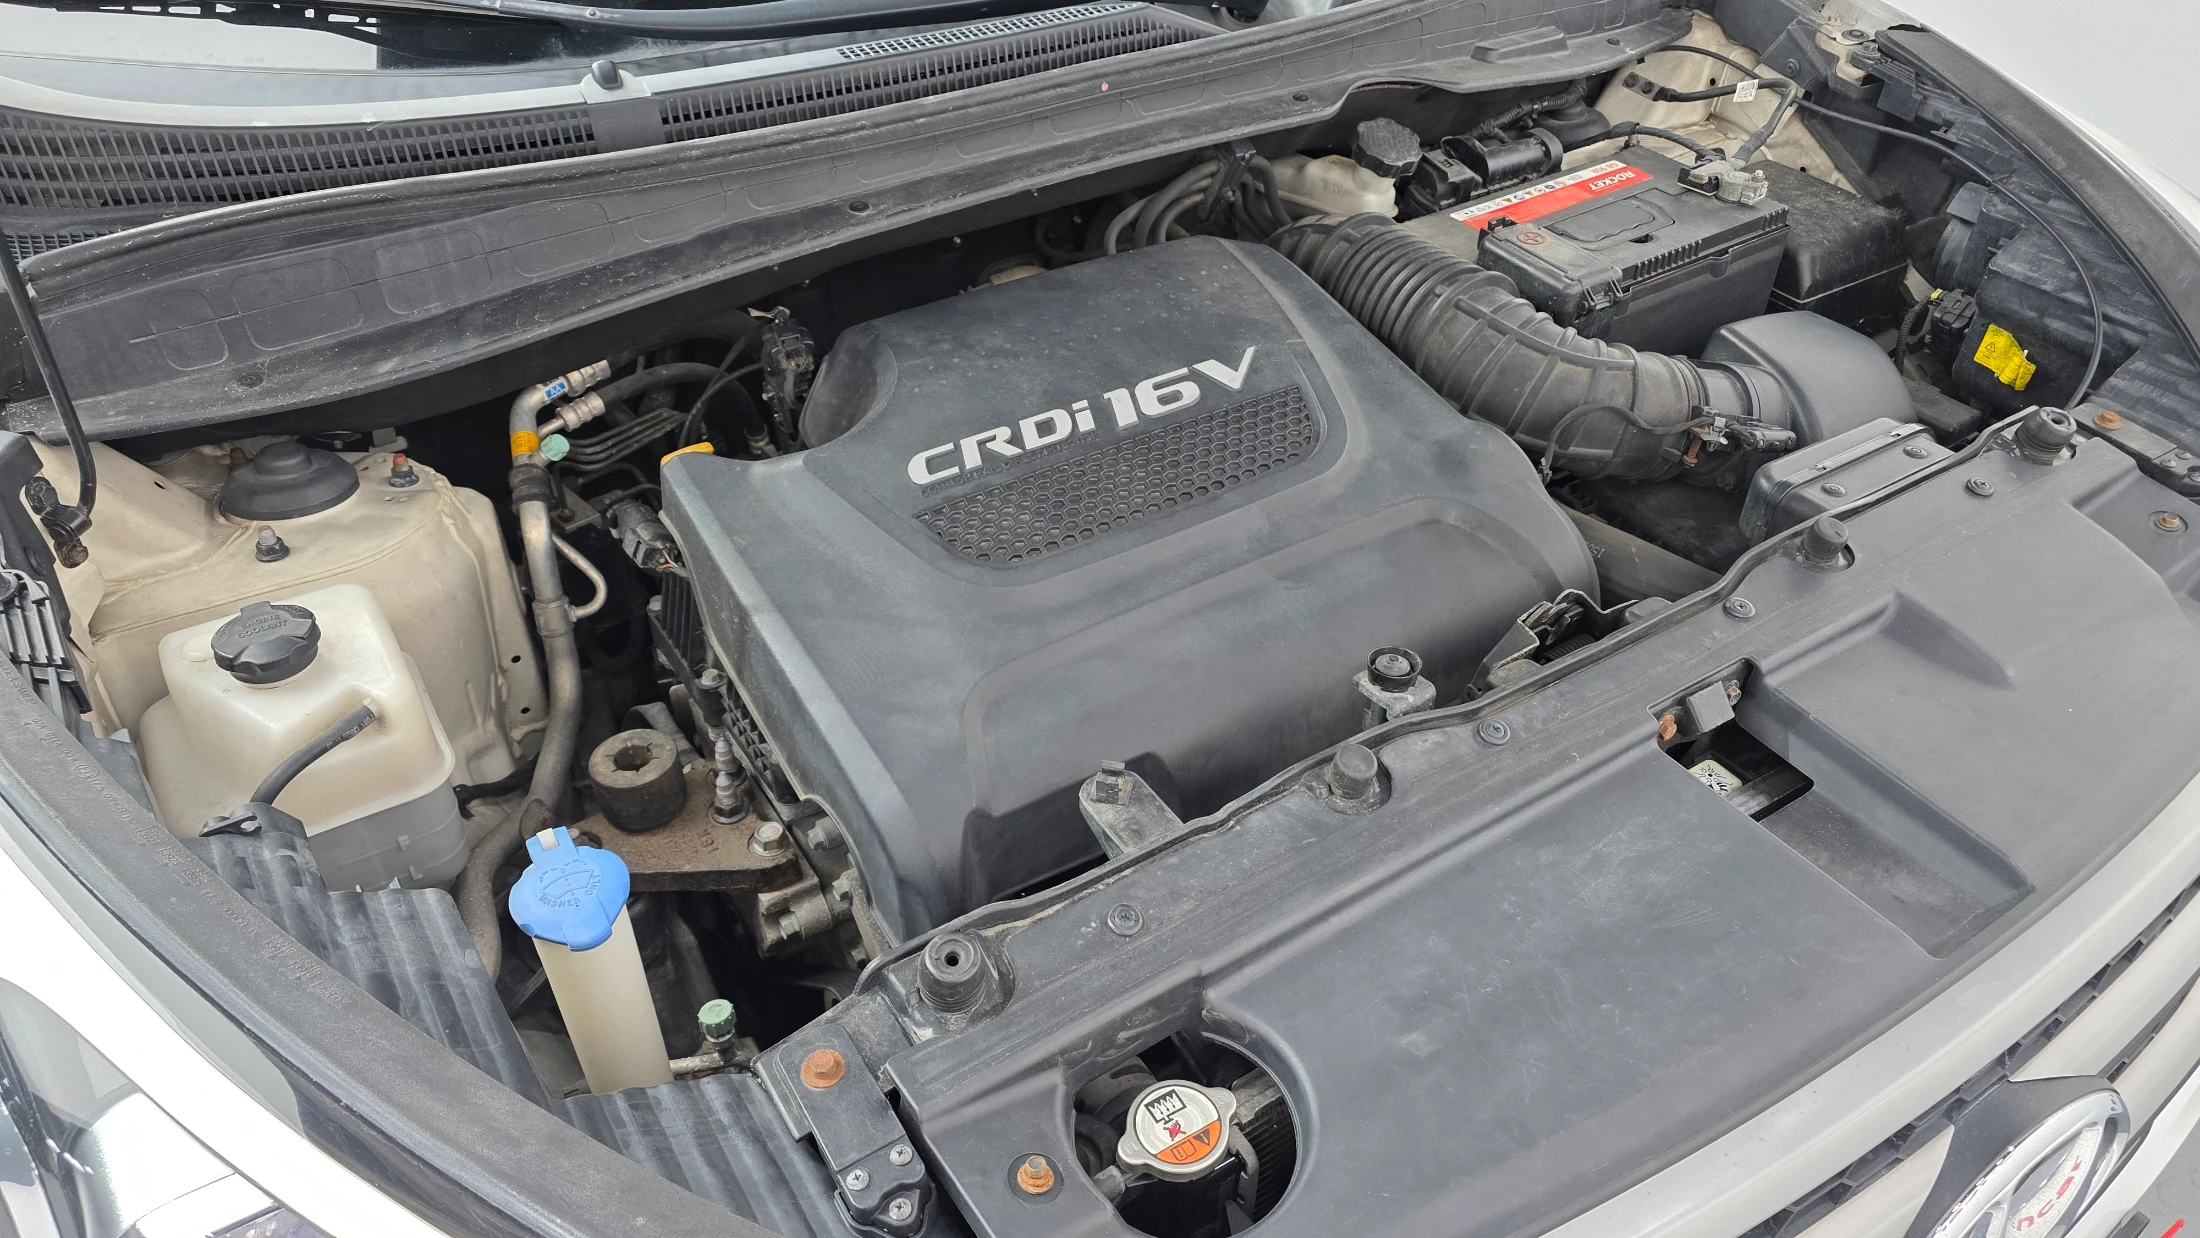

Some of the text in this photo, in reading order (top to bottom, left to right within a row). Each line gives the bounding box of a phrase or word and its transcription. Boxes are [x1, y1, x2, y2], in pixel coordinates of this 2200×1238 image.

[1588, 170, 1637, 191] ROCKET
[550, 384, 562, 396] AA
[907, 345, 1256, 485] CRDi 16V
[237, 620, 289, 639] COOLANT
[241, 614, 282, 630] ENGINE
[585, 873, 602, 896] ONLY
[538, 894, 582, 909] WASHER
